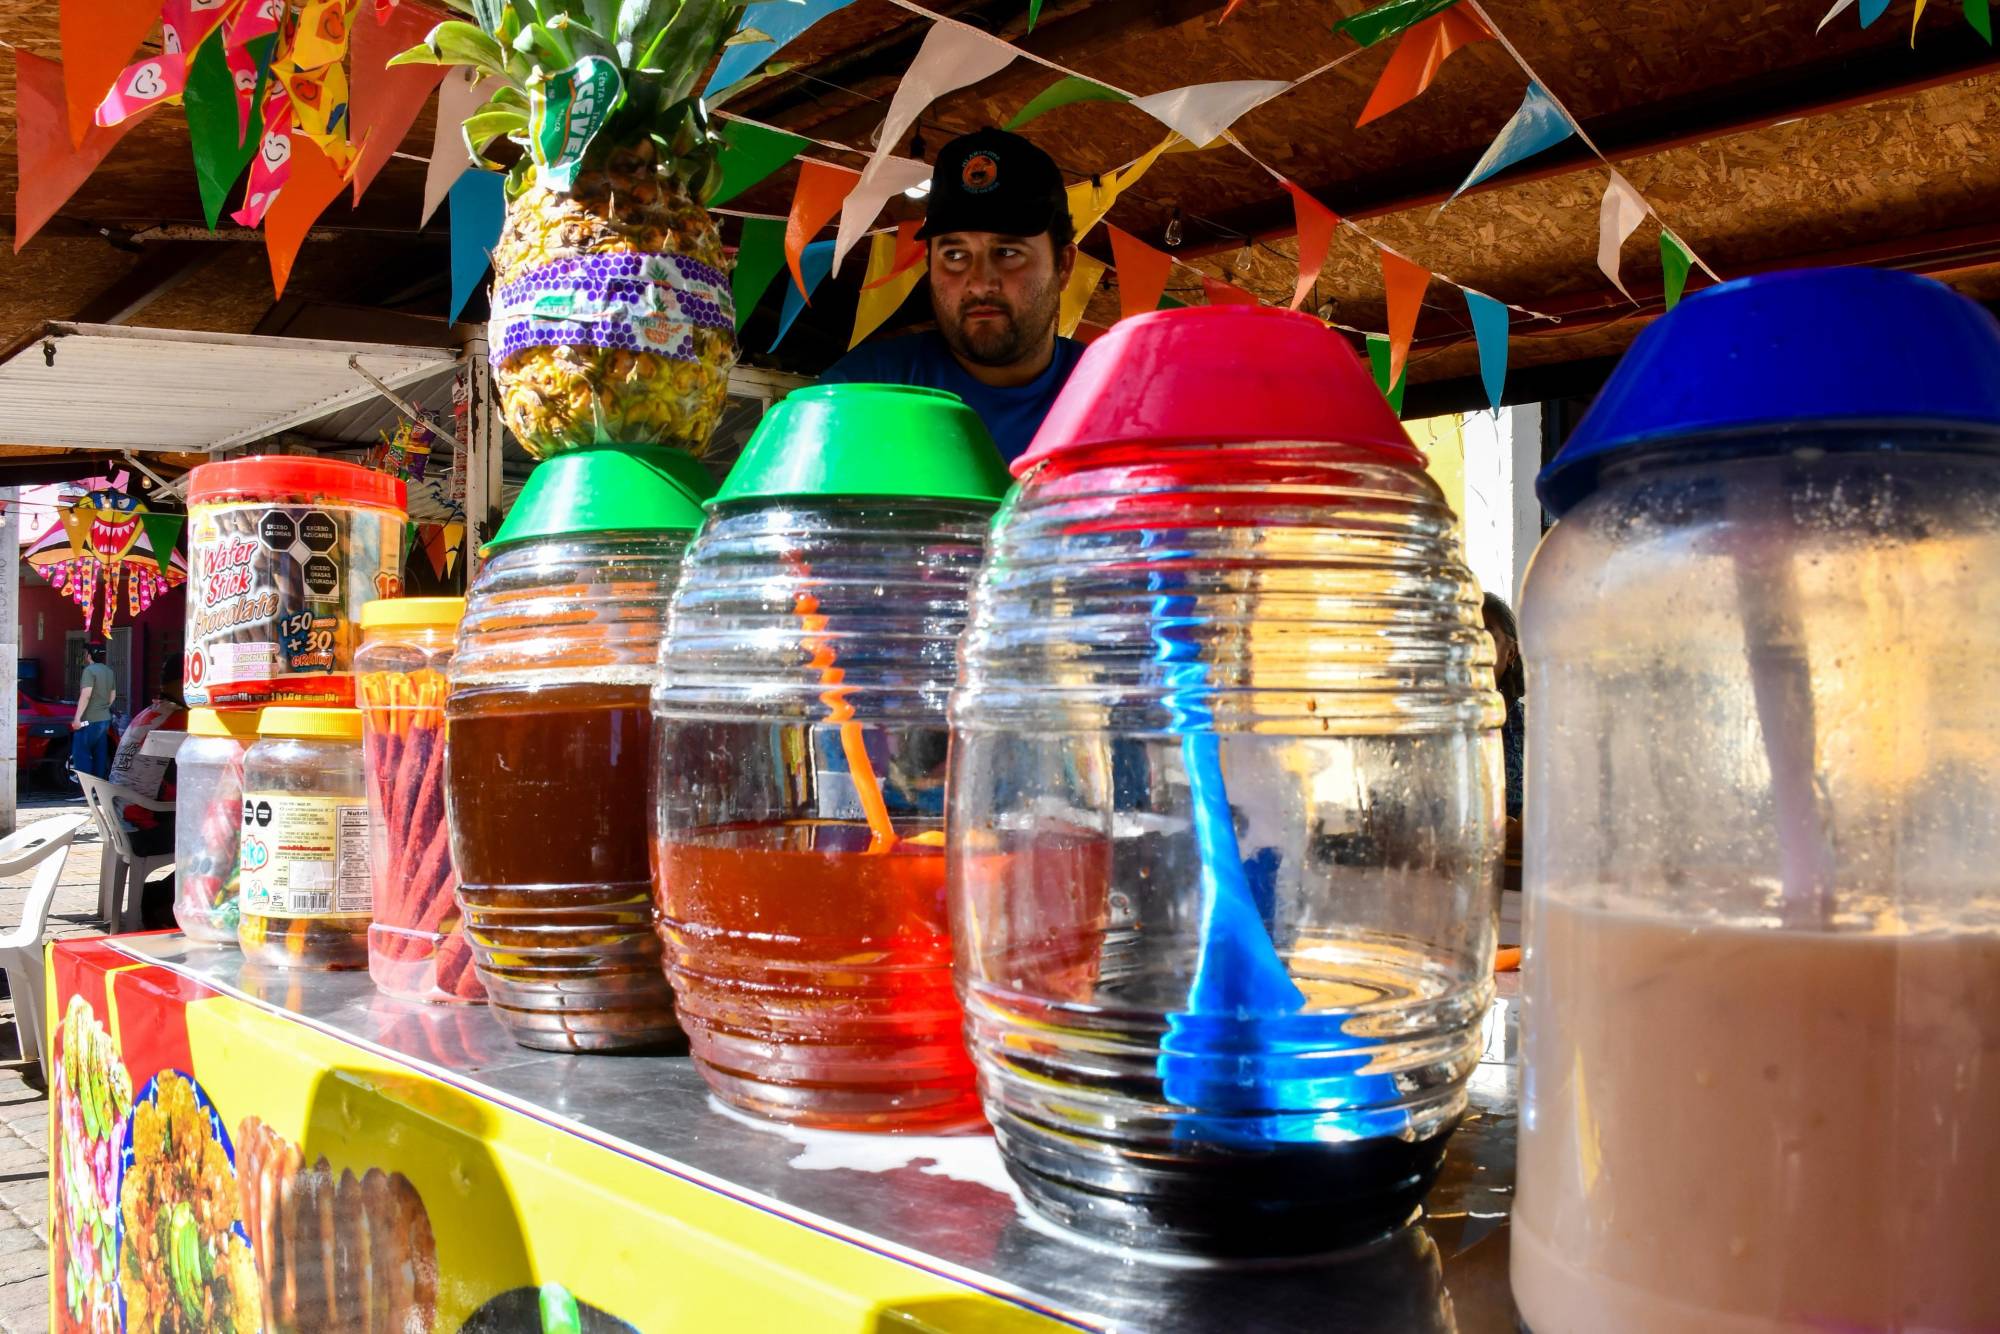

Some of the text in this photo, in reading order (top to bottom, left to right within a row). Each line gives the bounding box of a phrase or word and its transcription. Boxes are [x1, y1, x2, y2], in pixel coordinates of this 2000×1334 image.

[203, 537, 258, 577] Wafer
[206, 565, 252, 607] Stick
[192, 592, 279, 643] Chocolate
[281, 611, 313, 637] 150
[304, 630, 332, 652] 30
